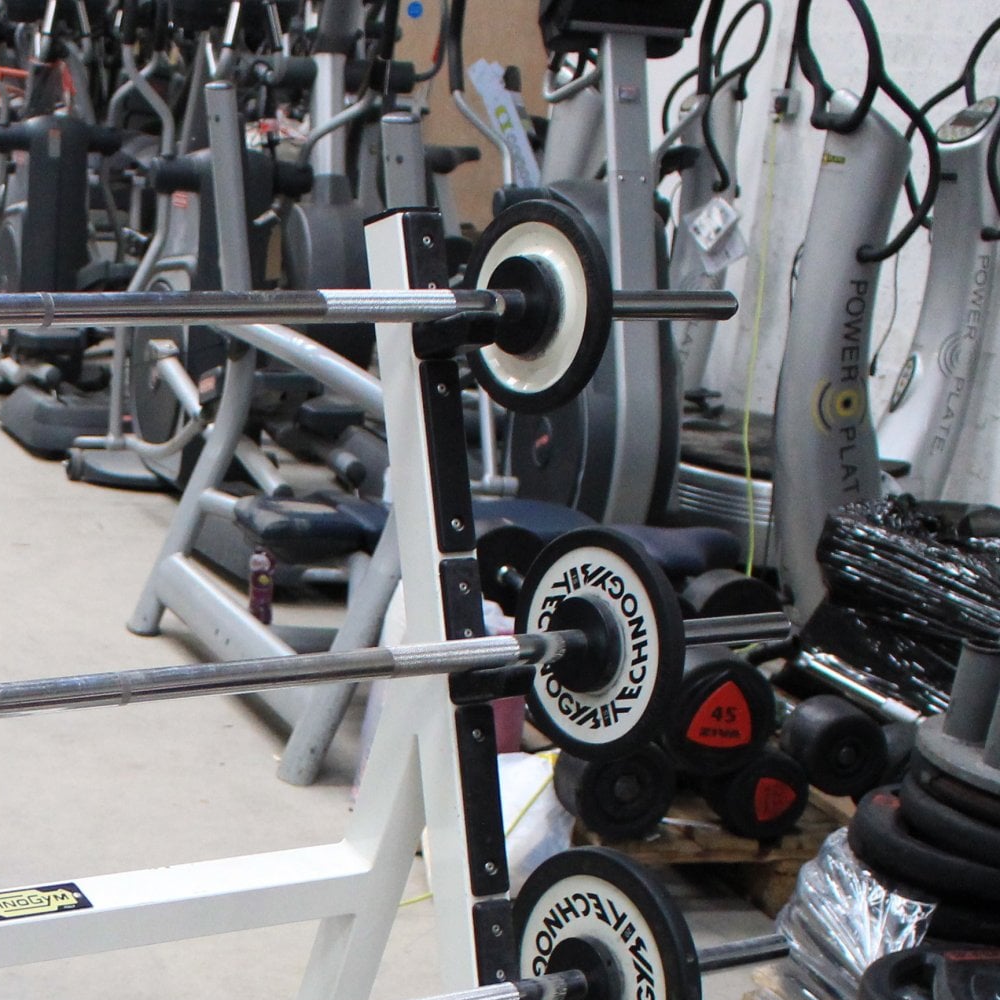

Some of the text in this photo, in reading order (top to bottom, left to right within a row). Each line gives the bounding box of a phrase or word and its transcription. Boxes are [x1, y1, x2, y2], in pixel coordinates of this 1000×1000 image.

[841, 280, 868, 383] POWER
[966, 255, 990, 339] POWER
[931, 378, 965, 453] PLATE
[839, 426, 860, 494] PLAT
[581, 563, 648, 723] TECHNOGYM
[711, 706, 737, 722] 45
